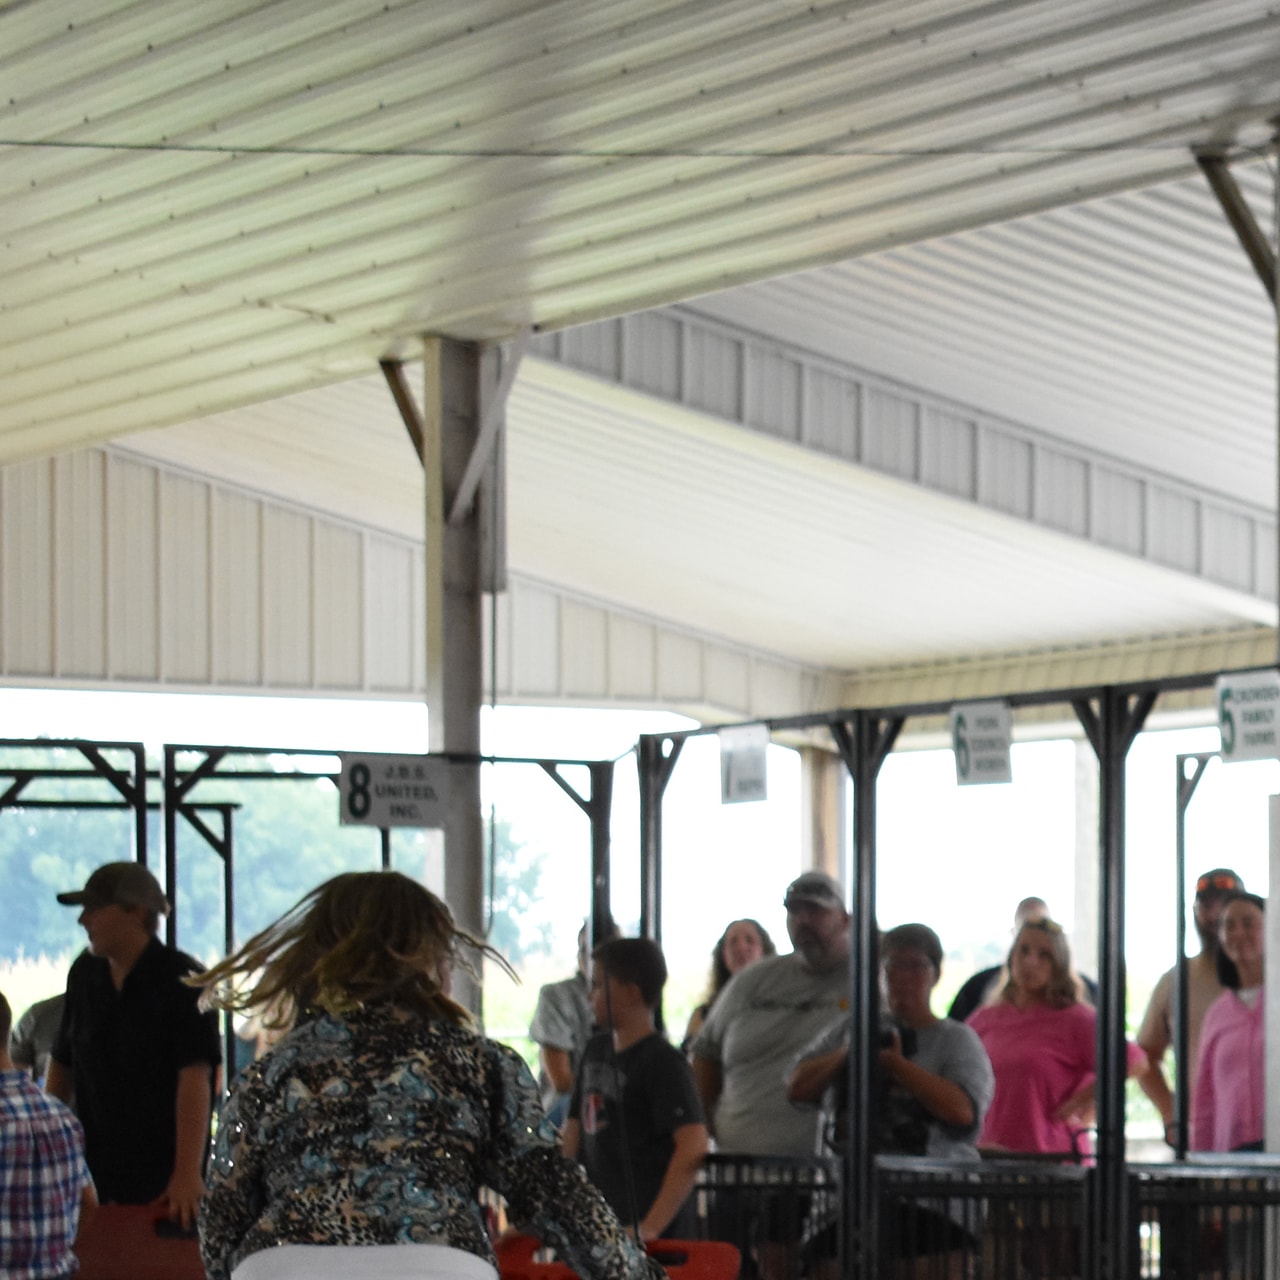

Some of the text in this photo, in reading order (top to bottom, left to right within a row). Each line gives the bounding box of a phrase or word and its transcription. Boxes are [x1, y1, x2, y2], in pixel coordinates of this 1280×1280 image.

[955, 712, 970, 778] 6
[1220, 687, 1236, 755] 5
[348, 762, 371, 819] 8
[375, 784, 438, 801] UNITED,
